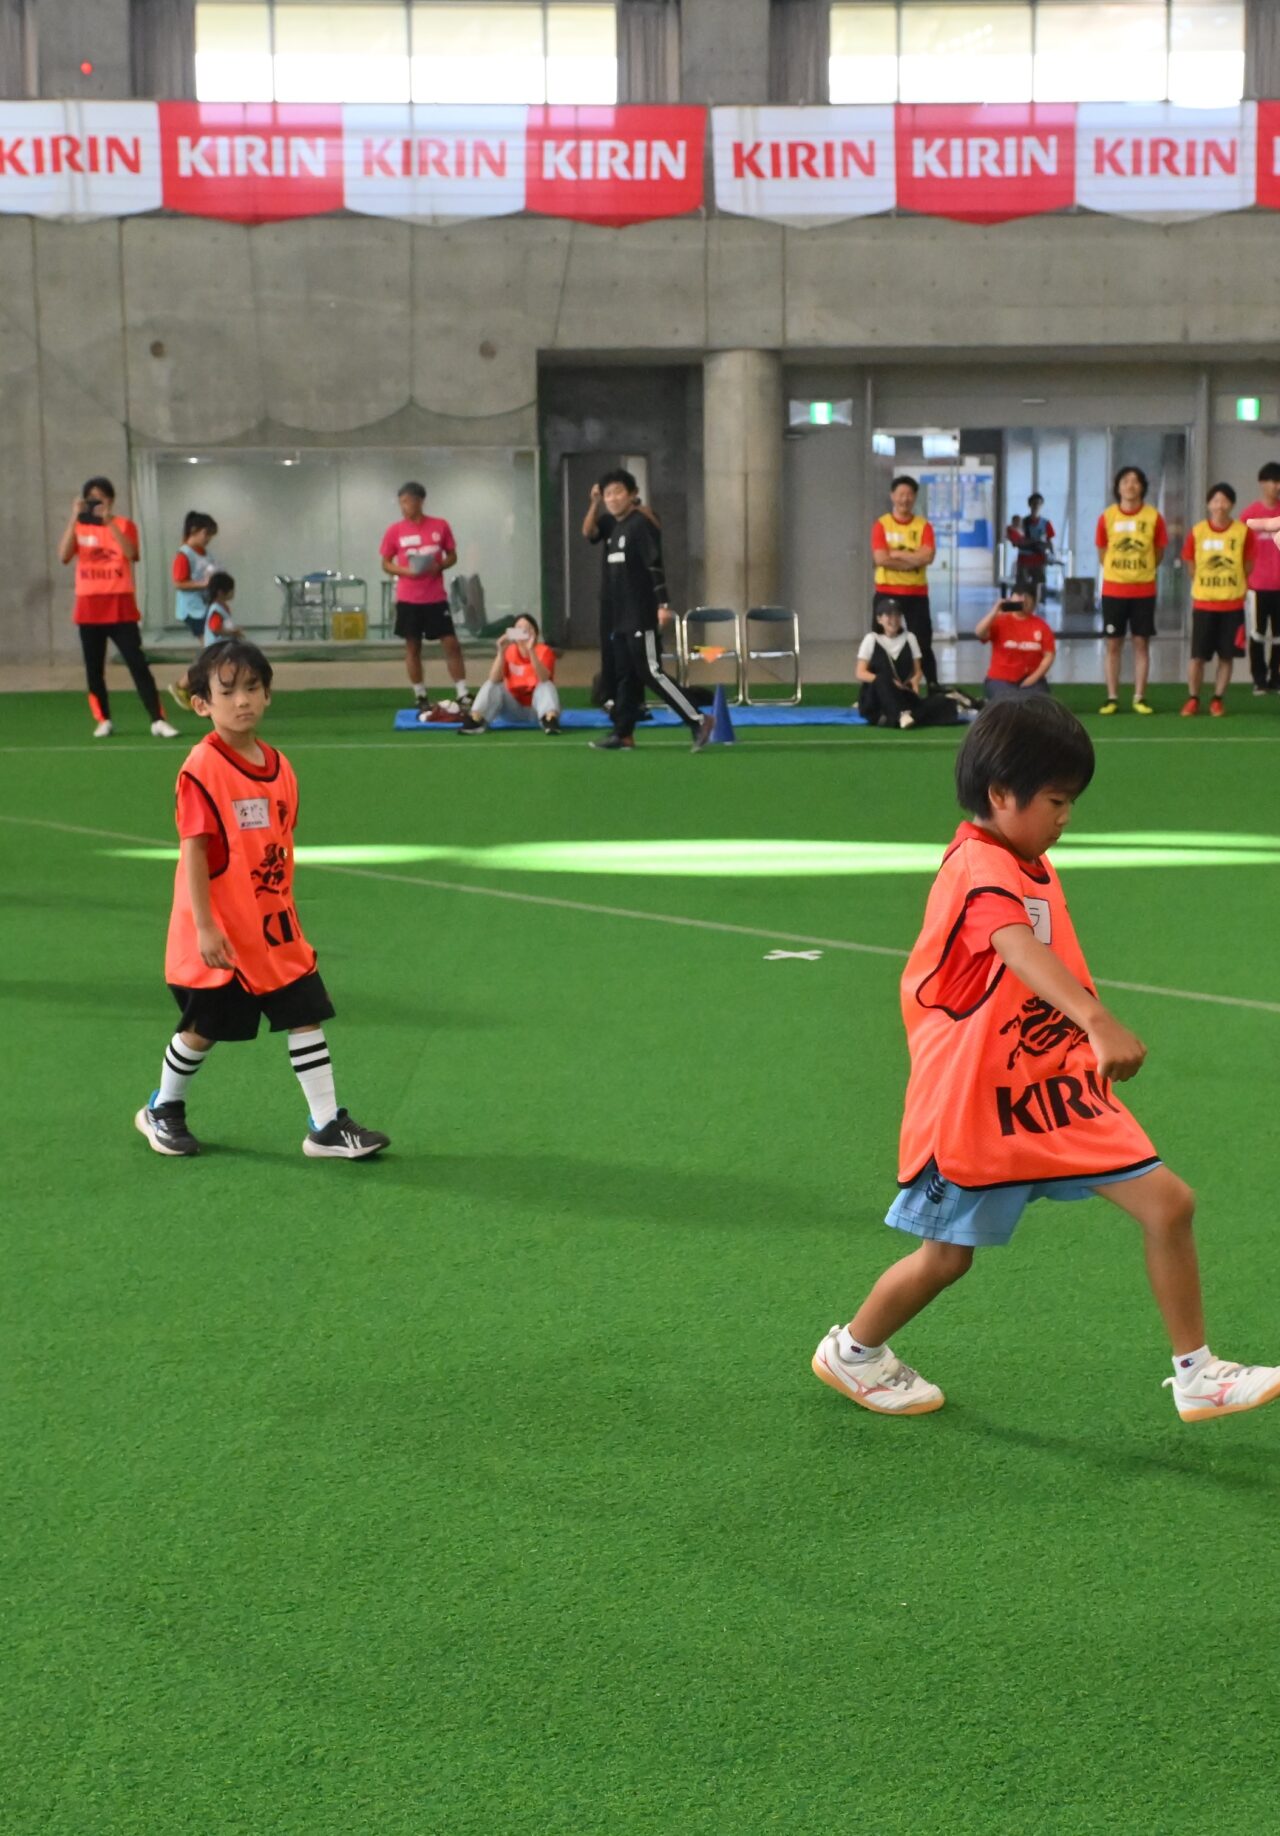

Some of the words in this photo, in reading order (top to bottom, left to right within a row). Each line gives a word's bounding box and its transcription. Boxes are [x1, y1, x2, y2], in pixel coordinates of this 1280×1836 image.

[0, 135, 140, 177] KIRIN
[177, 135, 326, 178] KIRIN
[362, 138, 507, 179] KIRIN
[541, 140, 687, 181] KIRIN
[732, 140, 876, 180] KIRIN
[911, 134, 1059, 178] KIRIN
[1093, 137, 1238, 177] KIRIN
